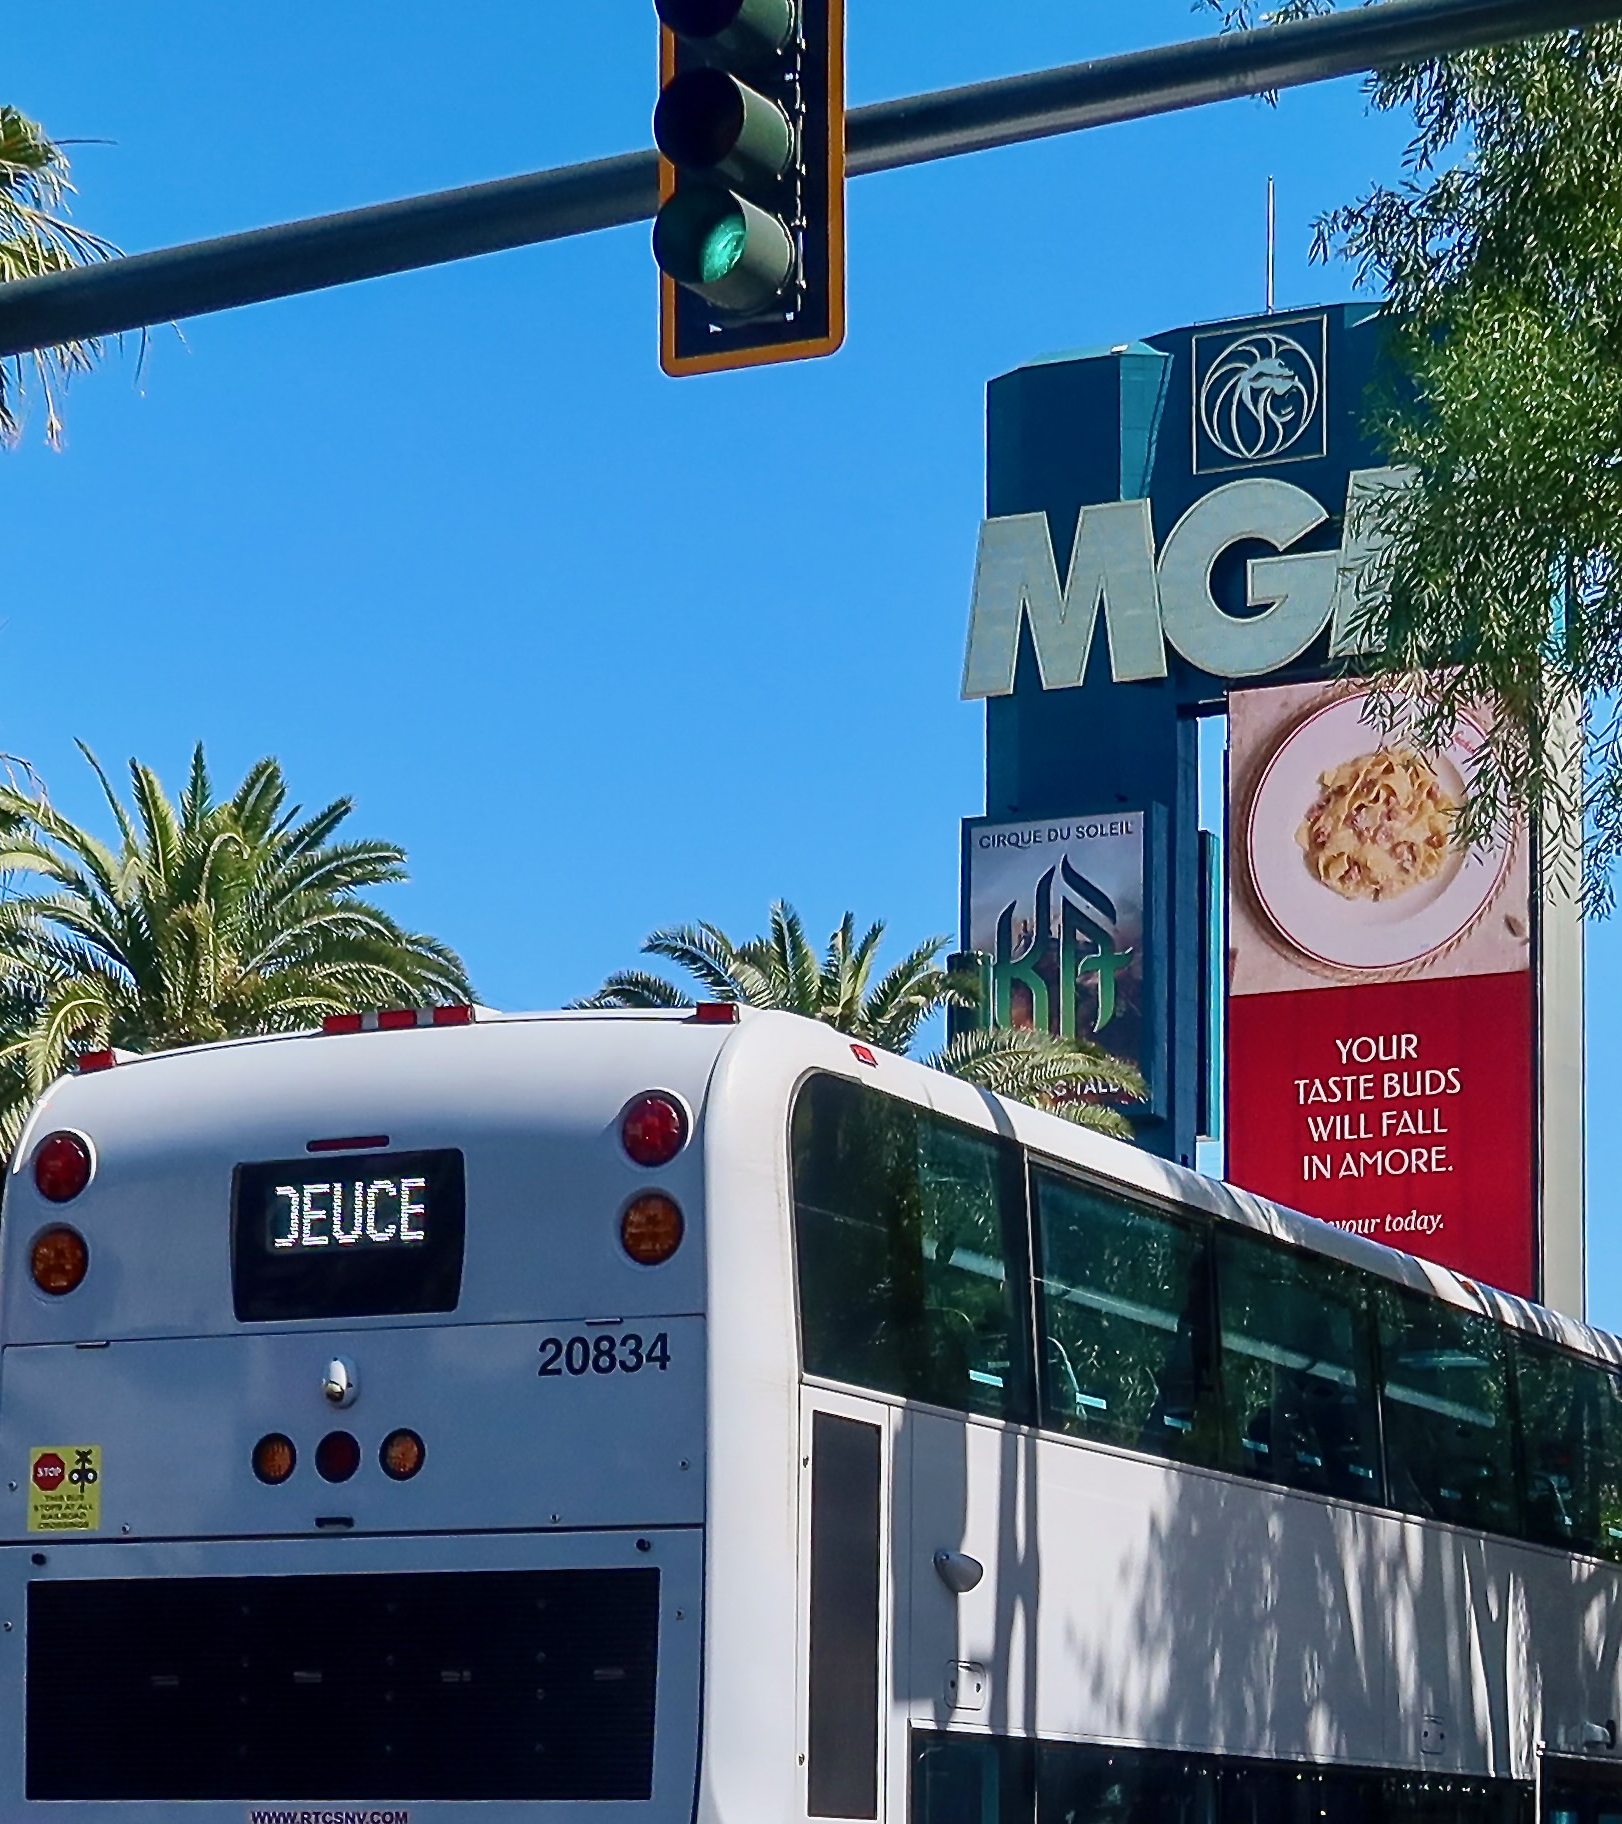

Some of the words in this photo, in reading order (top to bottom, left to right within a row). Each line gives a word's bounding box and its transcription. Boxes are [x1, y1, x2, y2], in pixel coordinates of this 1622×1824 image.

[979, 830, 1042, 850] CIRQUE
[1048, 826, 1071, 842] DU
[1076, 820, 1133, 838] SOLEIL
[1335, 1033, 1418, 1065] YOUR
[1294, 1074, 1375, 1105] TASTE
[1383, 1067, 1461, 1099] BUDS
[1307, 1113, 1374, 1142] WILL
[1382, 1107, 1448, 1137] FALL
[1303, 1153, 1331, 1181] IN
[1338, 1145, 1454, 1179] AMORE.
[275, 1178, 425, 1248] DEUCE
[1385, 1209, 1444, 1235] today.
[538, 1333, 671, 1377] 20834
[37, 1467, 61, 1477] STOP
